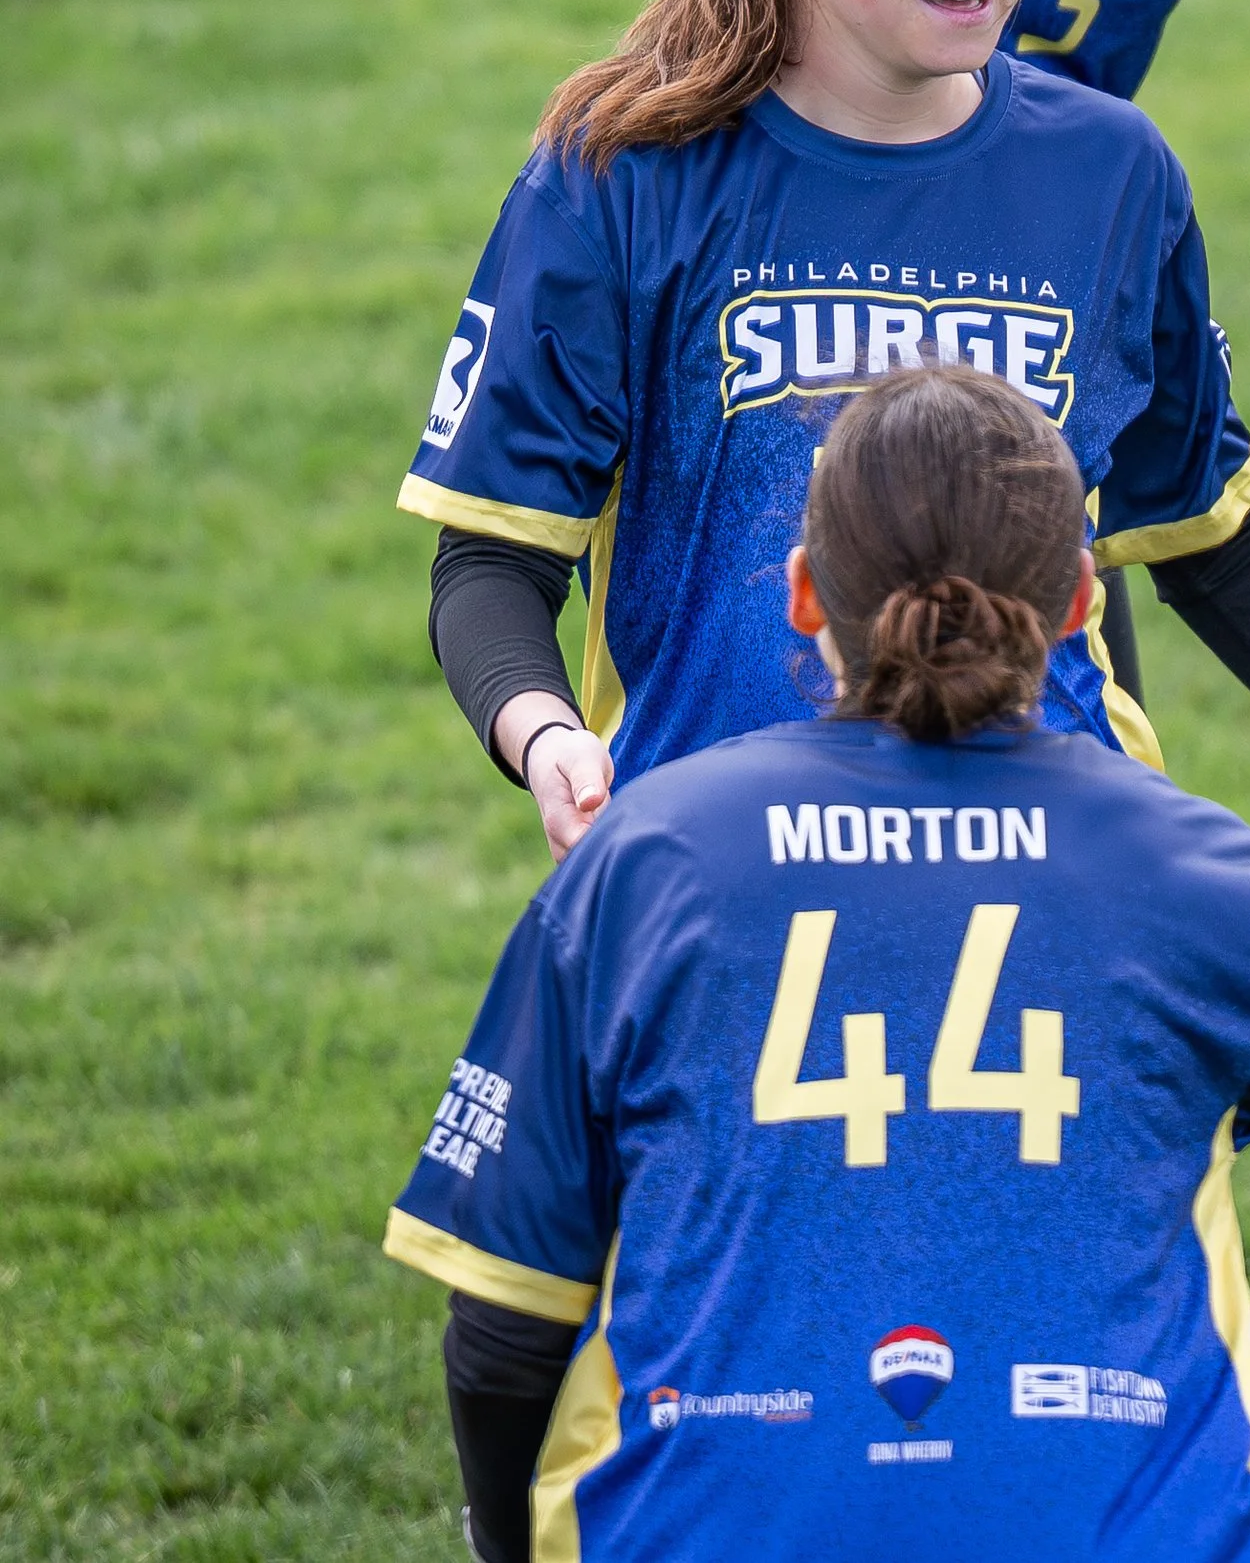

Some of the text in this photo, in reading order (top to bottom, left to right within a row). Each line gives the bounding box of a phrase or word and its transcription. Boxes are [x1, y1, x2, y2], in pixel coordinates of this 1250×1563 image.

[732, 261, 1058, 300] PHILADELPHIA
[729, 302, 1061, 408] SURGE
[765, 803, 1047, 864] MORTON
[753, 903, 1081, 1168] 44
